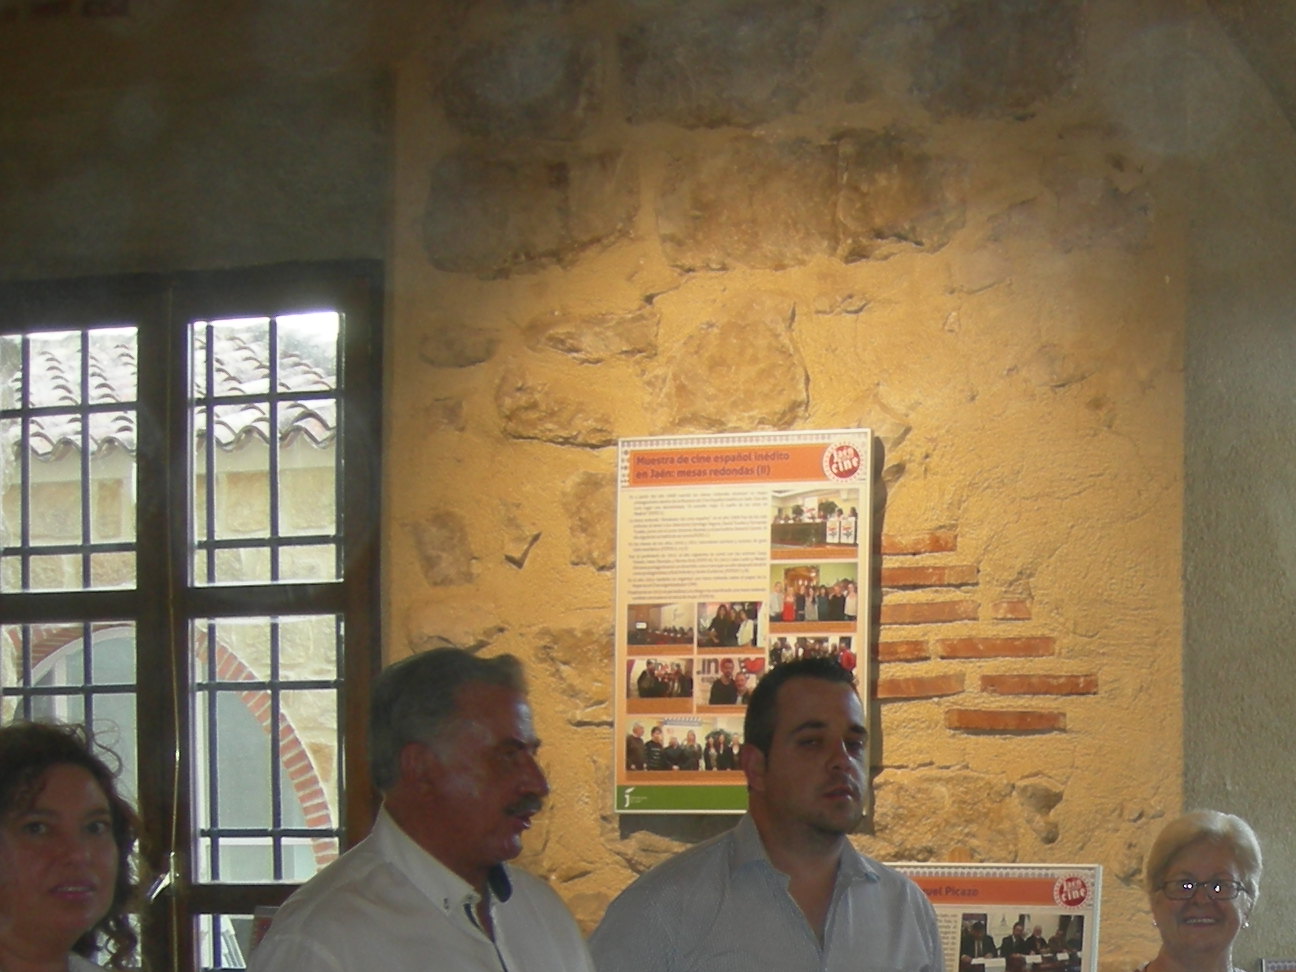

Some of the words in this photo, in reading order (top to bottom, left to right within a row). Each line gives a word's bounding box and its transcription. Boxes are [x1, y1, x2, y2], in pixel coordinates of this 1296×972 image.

[636, 456, 675, 466] Muestra
[677, 455, 689, 464] de
[691, 454, 711, 464] cine
[714, 452, 751, 464] español
[754, 450, 790, 461] inédito
[636, 470, 648, 479] en
[677, 469, 707, 478] mesas
[709, 465, 755, 477] redondas
[945, 886, 980, 897] Picazo
